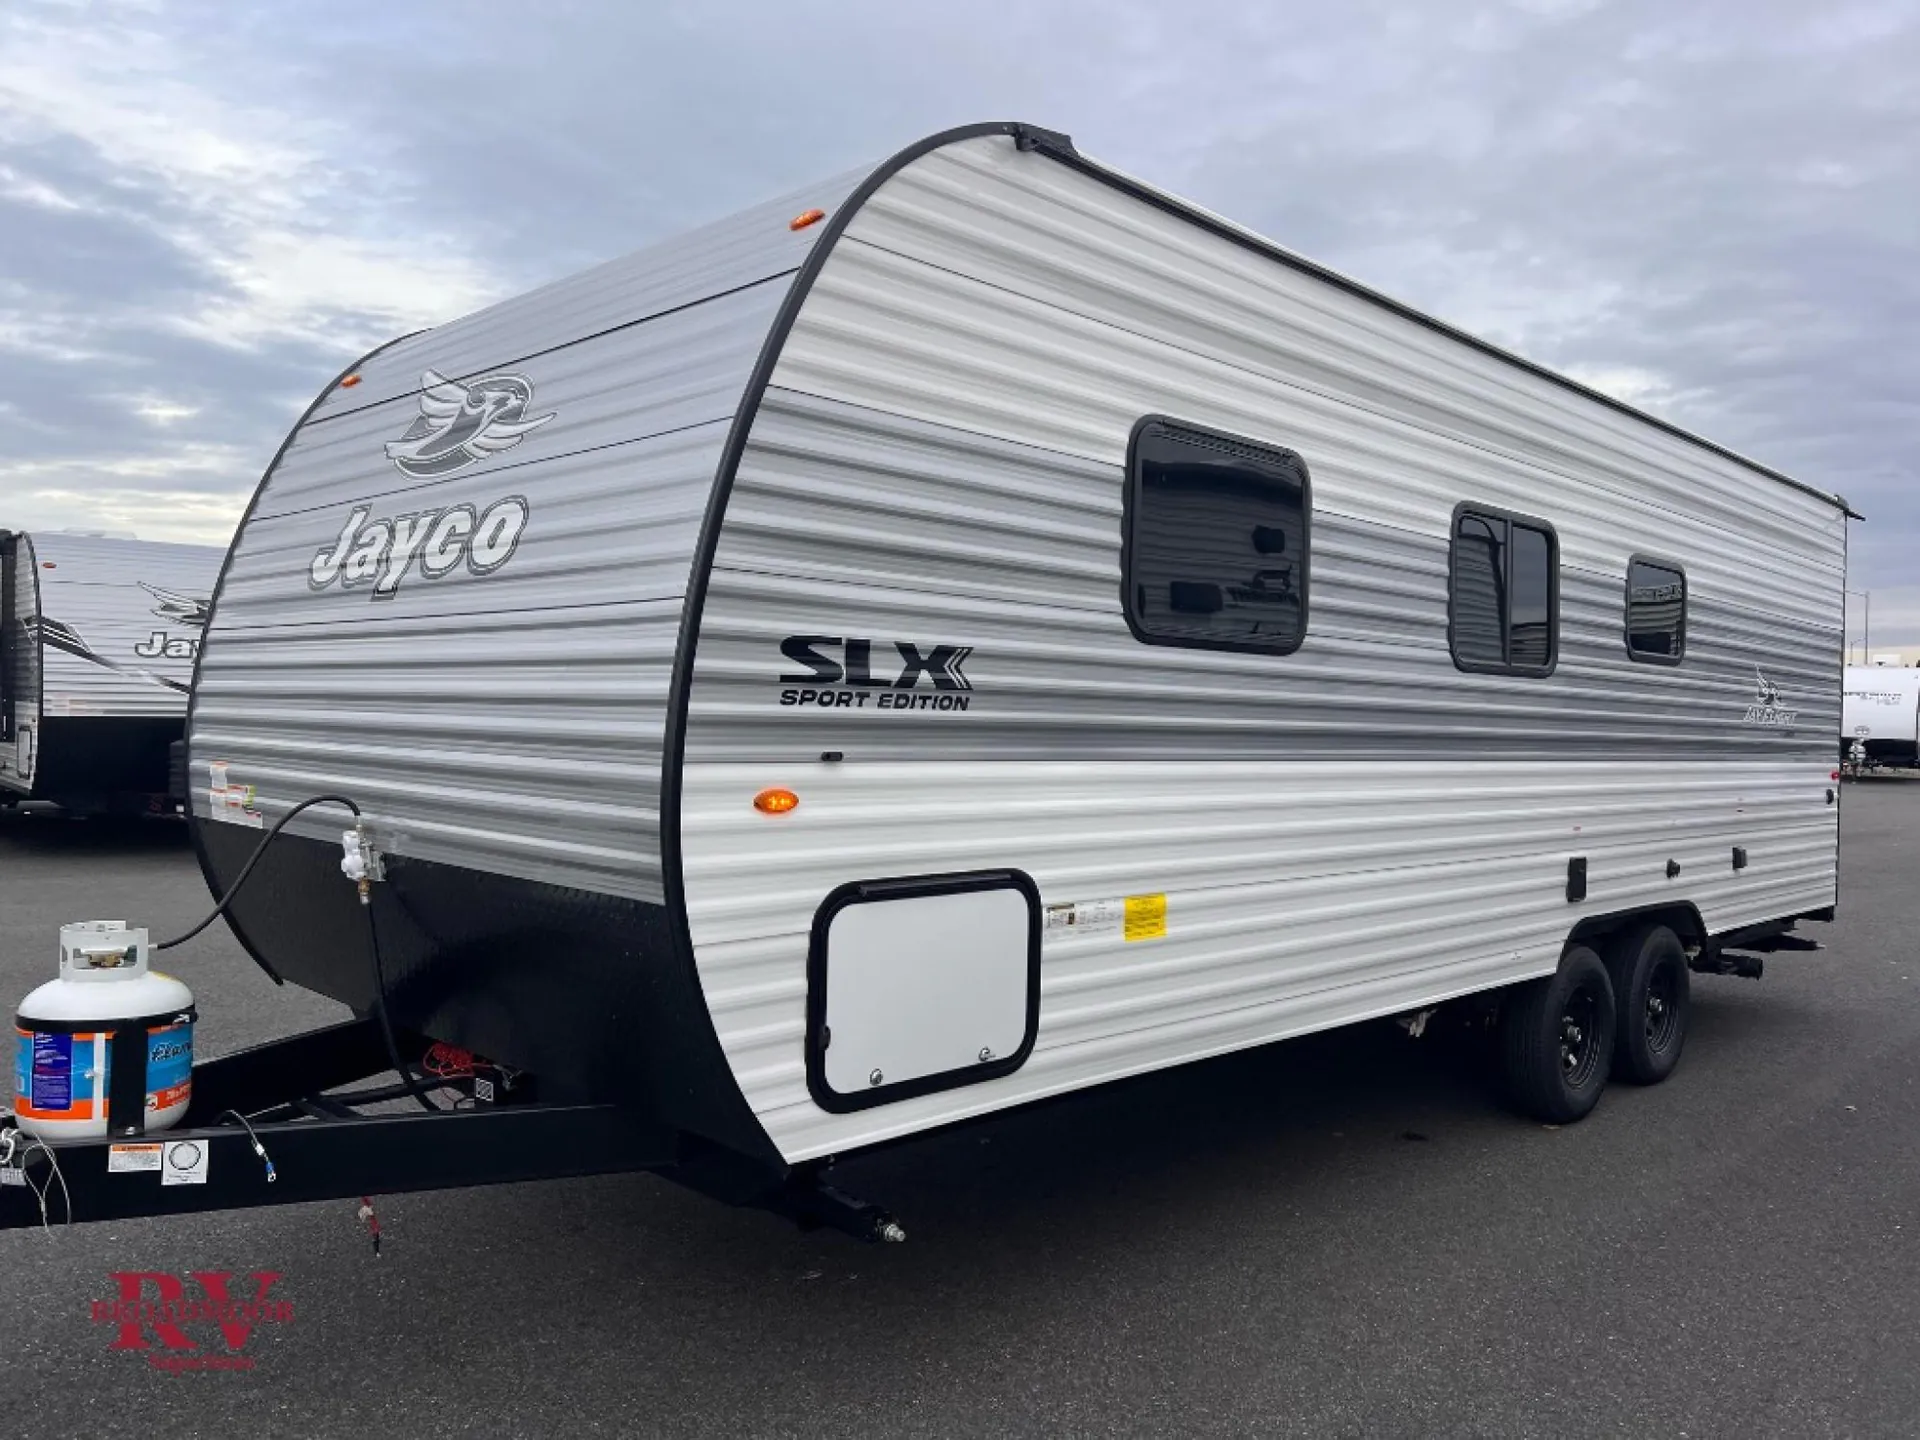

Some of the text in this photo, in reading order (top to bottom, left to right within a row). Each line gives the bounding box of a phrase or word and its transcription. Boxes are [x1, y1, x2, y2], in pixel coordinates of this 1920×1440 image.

[308, 495, 529, 601] Jayco
[780, 635, 974, 690] SLX
[780, 689, 970, 711] SPORT EDITION
